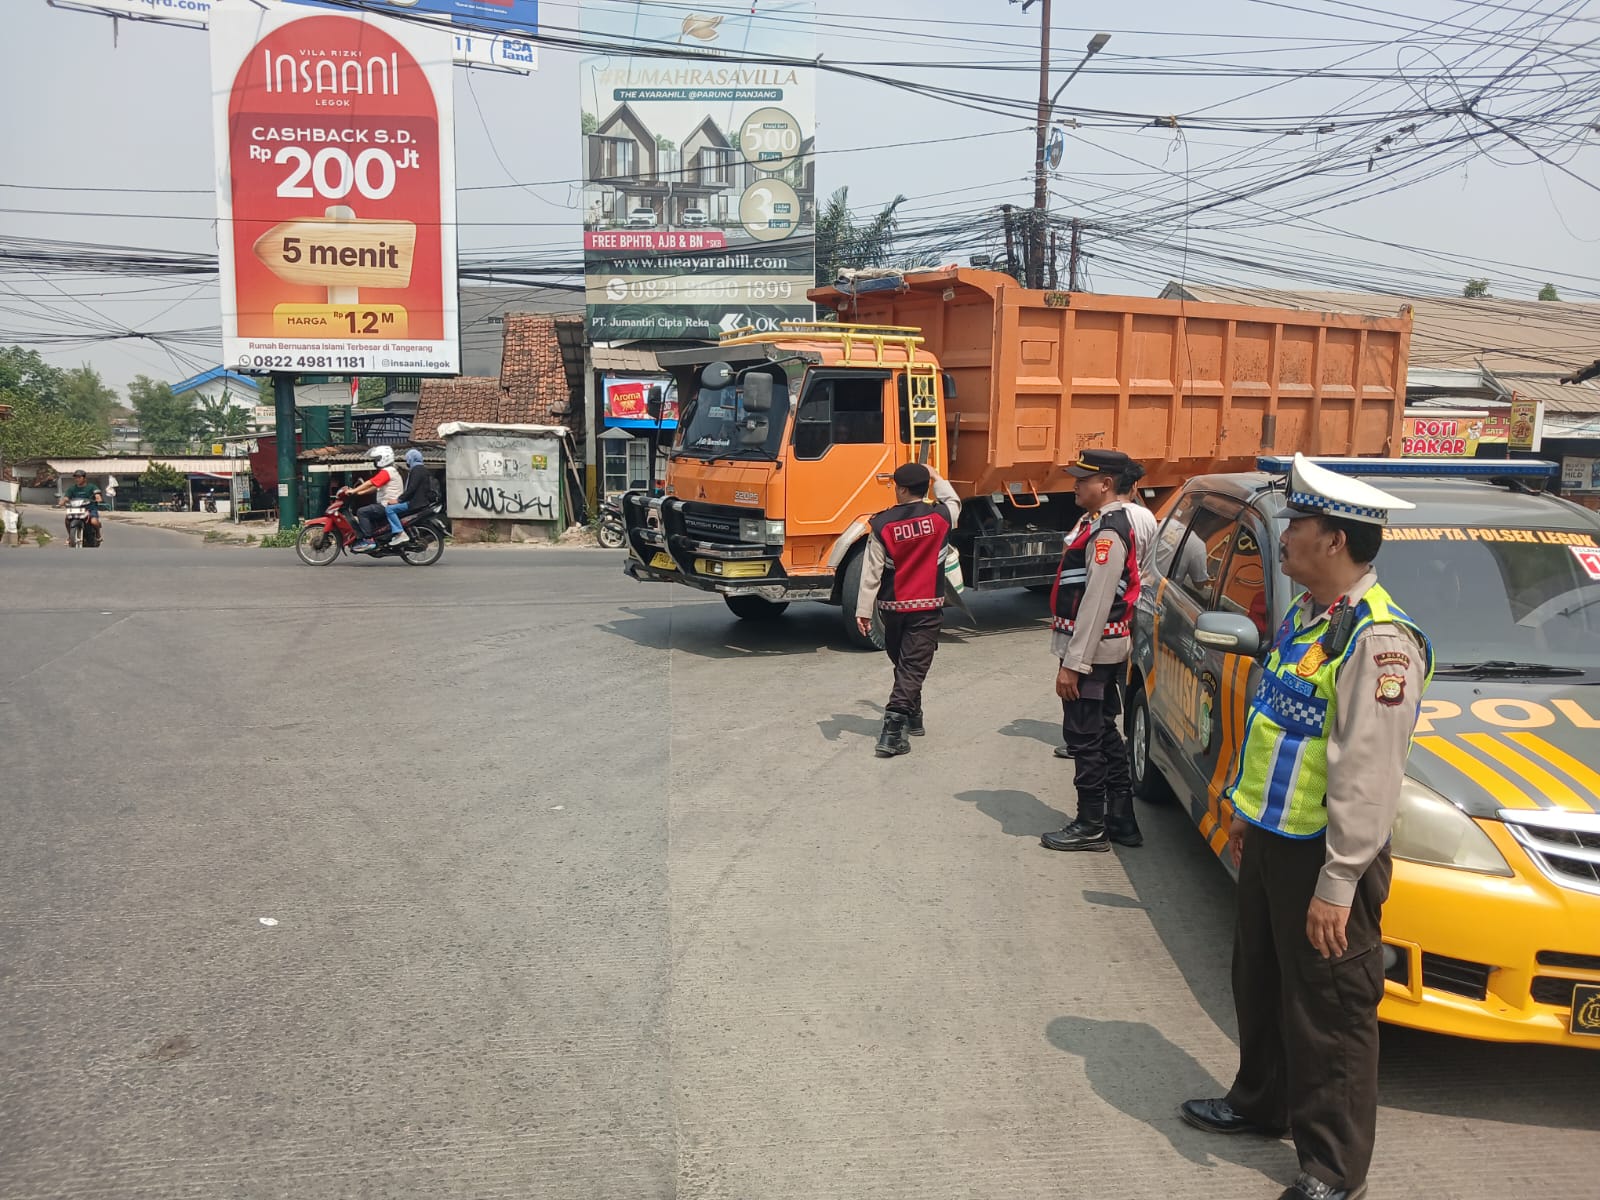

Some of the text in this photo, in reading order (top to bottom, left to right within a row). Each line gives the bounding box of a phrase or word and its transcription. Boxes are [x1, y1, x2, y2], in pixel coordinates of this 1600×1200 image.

[300, 49, 326, 57] VILA
[503, 49, 533, 62] land
[598, 68, 799, 86] #RUMAHRASAVILLA
[315, 99, 351, 107] LEGOK
[619, 90, 777, 100] THE AYARAHILL @PARUNG PANJANG
[251, 127, 417, 144] CASHBACK S.D.
[745, 122, 797, 151] 500
[250, 145, 420, 200] Rp 200 Jt
[750, 187, 773, 231] 3
[592, 235, 617, 248] FREE
[619, 235, 655, 249] BPHTB,
[658, 235, 676, 248] AJB
[679, 235, 687, 248] &
[689, 235, 703, 248] BN
[282, 237, 399, 269] 5 menit
[613, 255, 788, 271] www.theayarahill.com
[631, 280, 677, 299] 0821
[746, 280, 792, 300] 1899
[287, 311, 394, 334] HARGA Rp 1.2 M
[592, 318, 607, 327] PT.
[657, 318, 682, 329] Cipta
[685, 318, 710, 327] Reka
[248, 342, 433, 353] Rumah Bernuansa Islami Terbesar di Tangerang
[253, 355, 365, 369] 0822 4981 1181
[390, 358, 451, 368] insaani.legok
[613, 392, 641, 402] Aroma
[1414, 420, 1457, 437] ROTI
[1403, 438, 1466, 455] BAKAR
[893, 518, 935, 541] POLISI
[1381, 527, 1599, 547] SAMAPTA POLSEK LEGOK
[1414, 698, 1600, 732] POL
